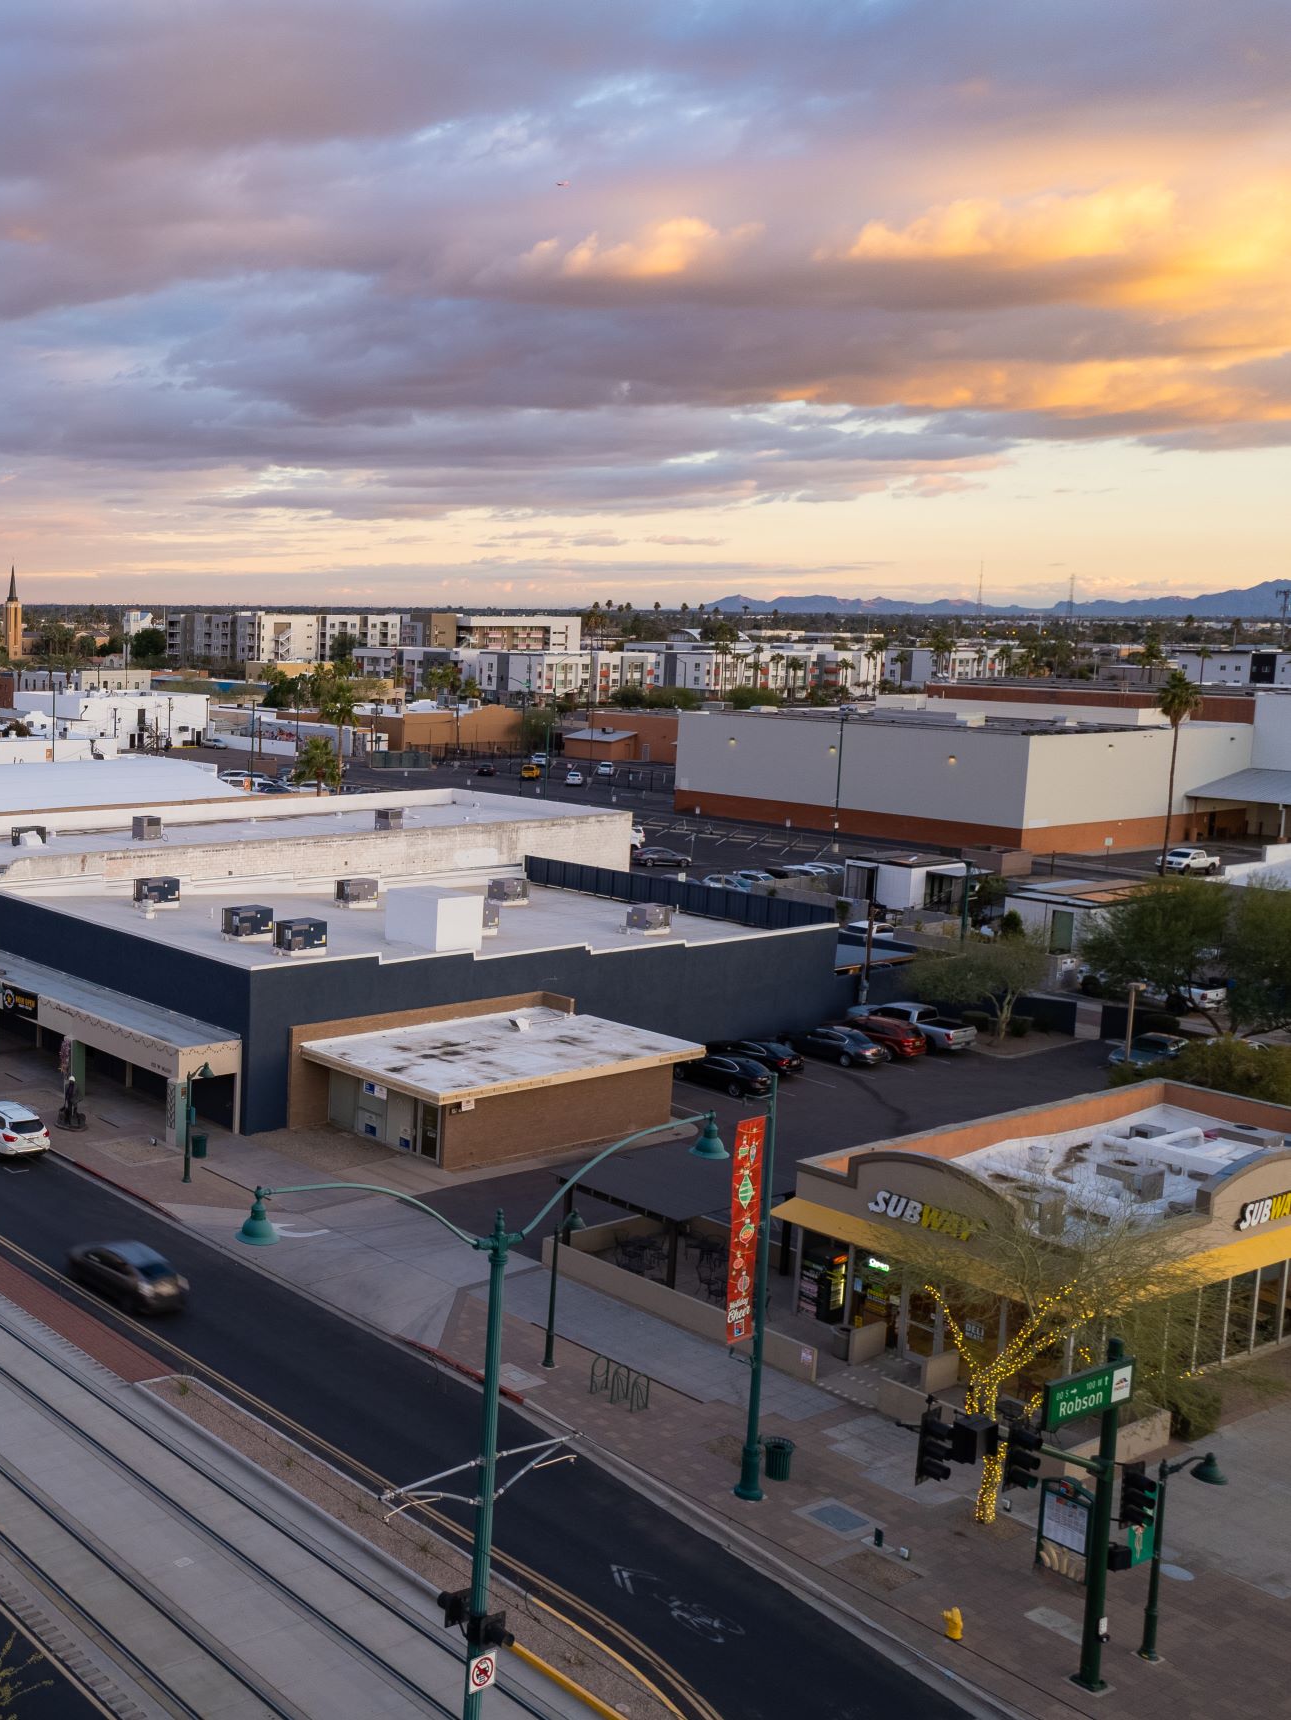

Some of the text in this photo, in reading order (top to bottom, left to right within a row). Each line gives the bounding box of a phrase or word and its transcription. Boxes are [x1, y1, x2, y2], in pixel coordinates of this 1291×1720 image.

[868, 1190, 989, 1241] SUBWAY
[965, 1322, 985, 1337] DELI
[1059, 1391, 1103, 1417] Robson
